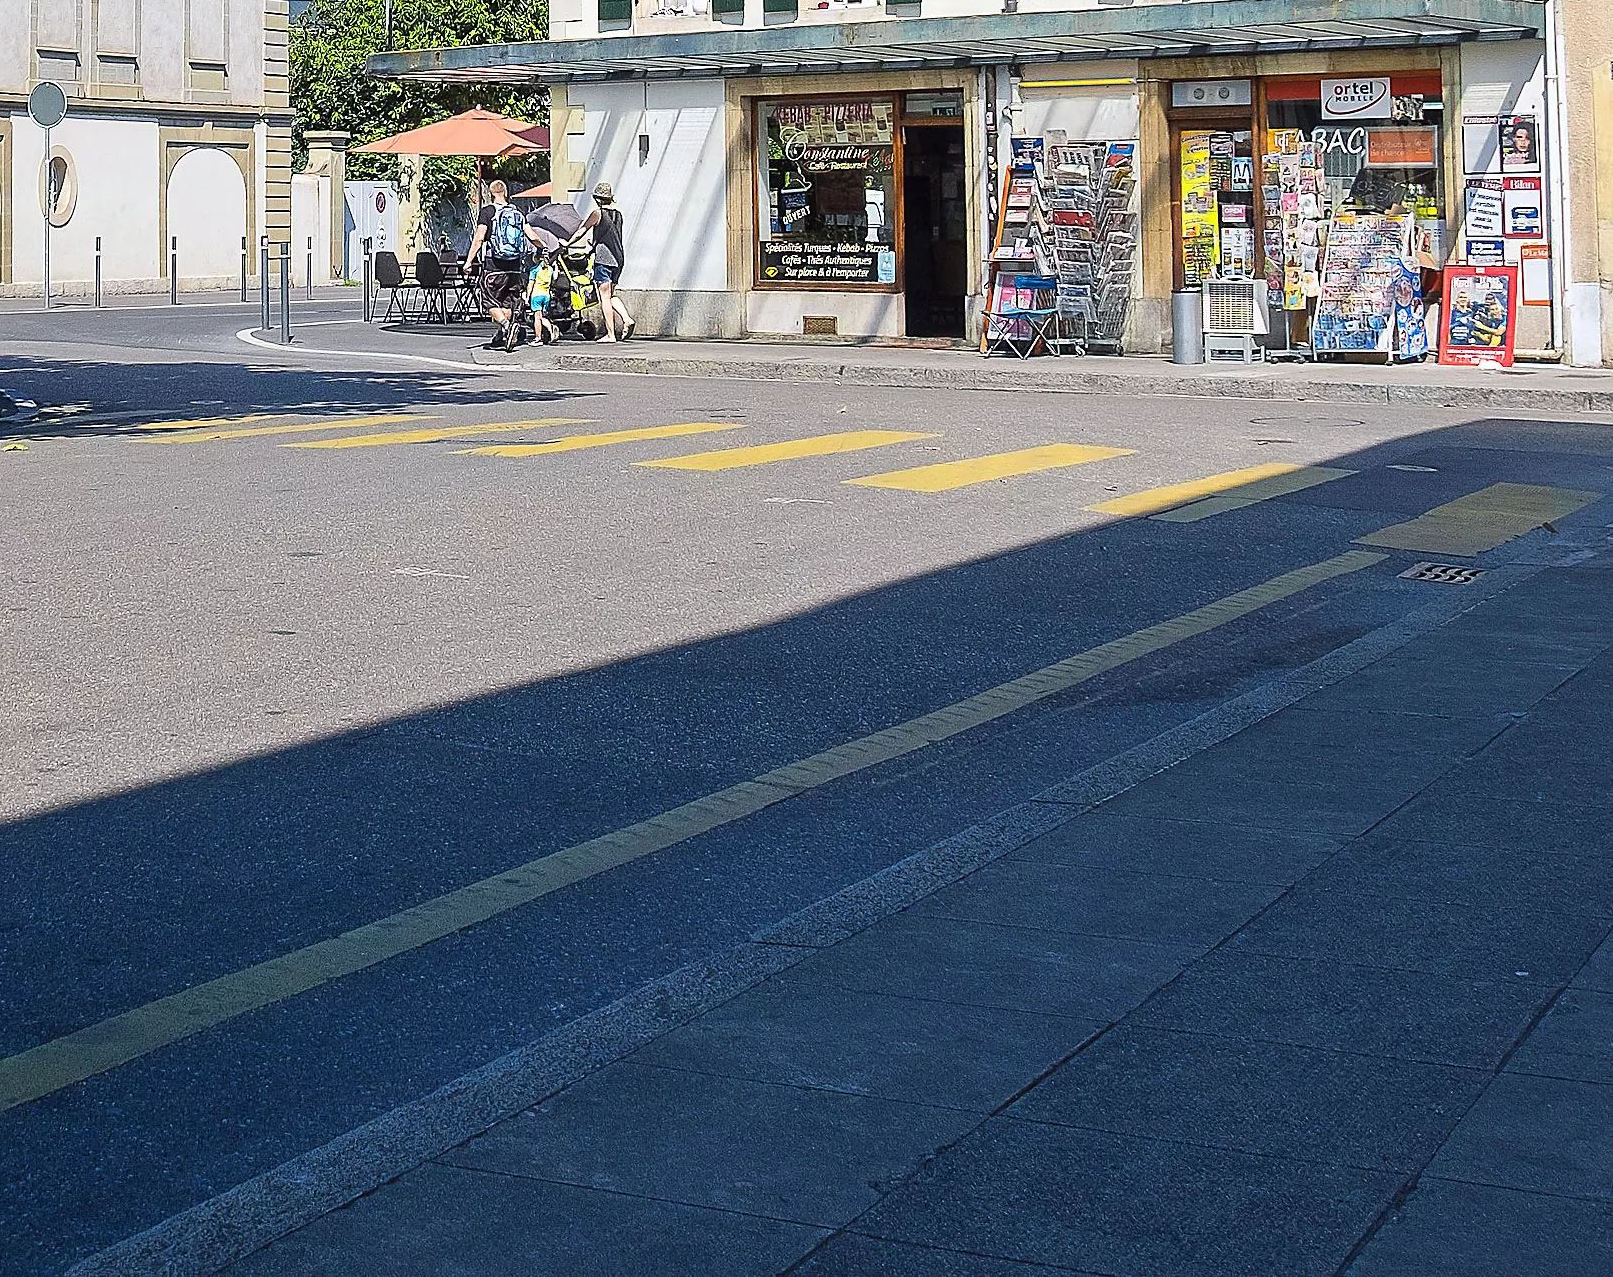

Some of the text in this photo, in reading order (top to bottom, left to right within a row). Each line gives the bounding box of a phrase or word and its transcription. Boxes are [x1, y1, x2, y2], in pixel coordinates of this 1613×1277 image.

[1334, 81, 1374, 96] ortel
[1335, 95, 1374, 103] MOBILE
[776, 103, 873, 123] KEBAB PIZZERIA
[780, 127, 869, 162] Constantine
[1274, 126, 1365, 155] TABAC
[1510, 179, 1535, 190] Bilan
[782, 205, 811, 225] OUVERT
[804, 243, 832, 254] Turques
[837, 243, 861, 253] Kebab
[785, 267, 797, 277] Sur
[798, 266, 816, 278] place
[832, 266, 870, 279] l'emporter
